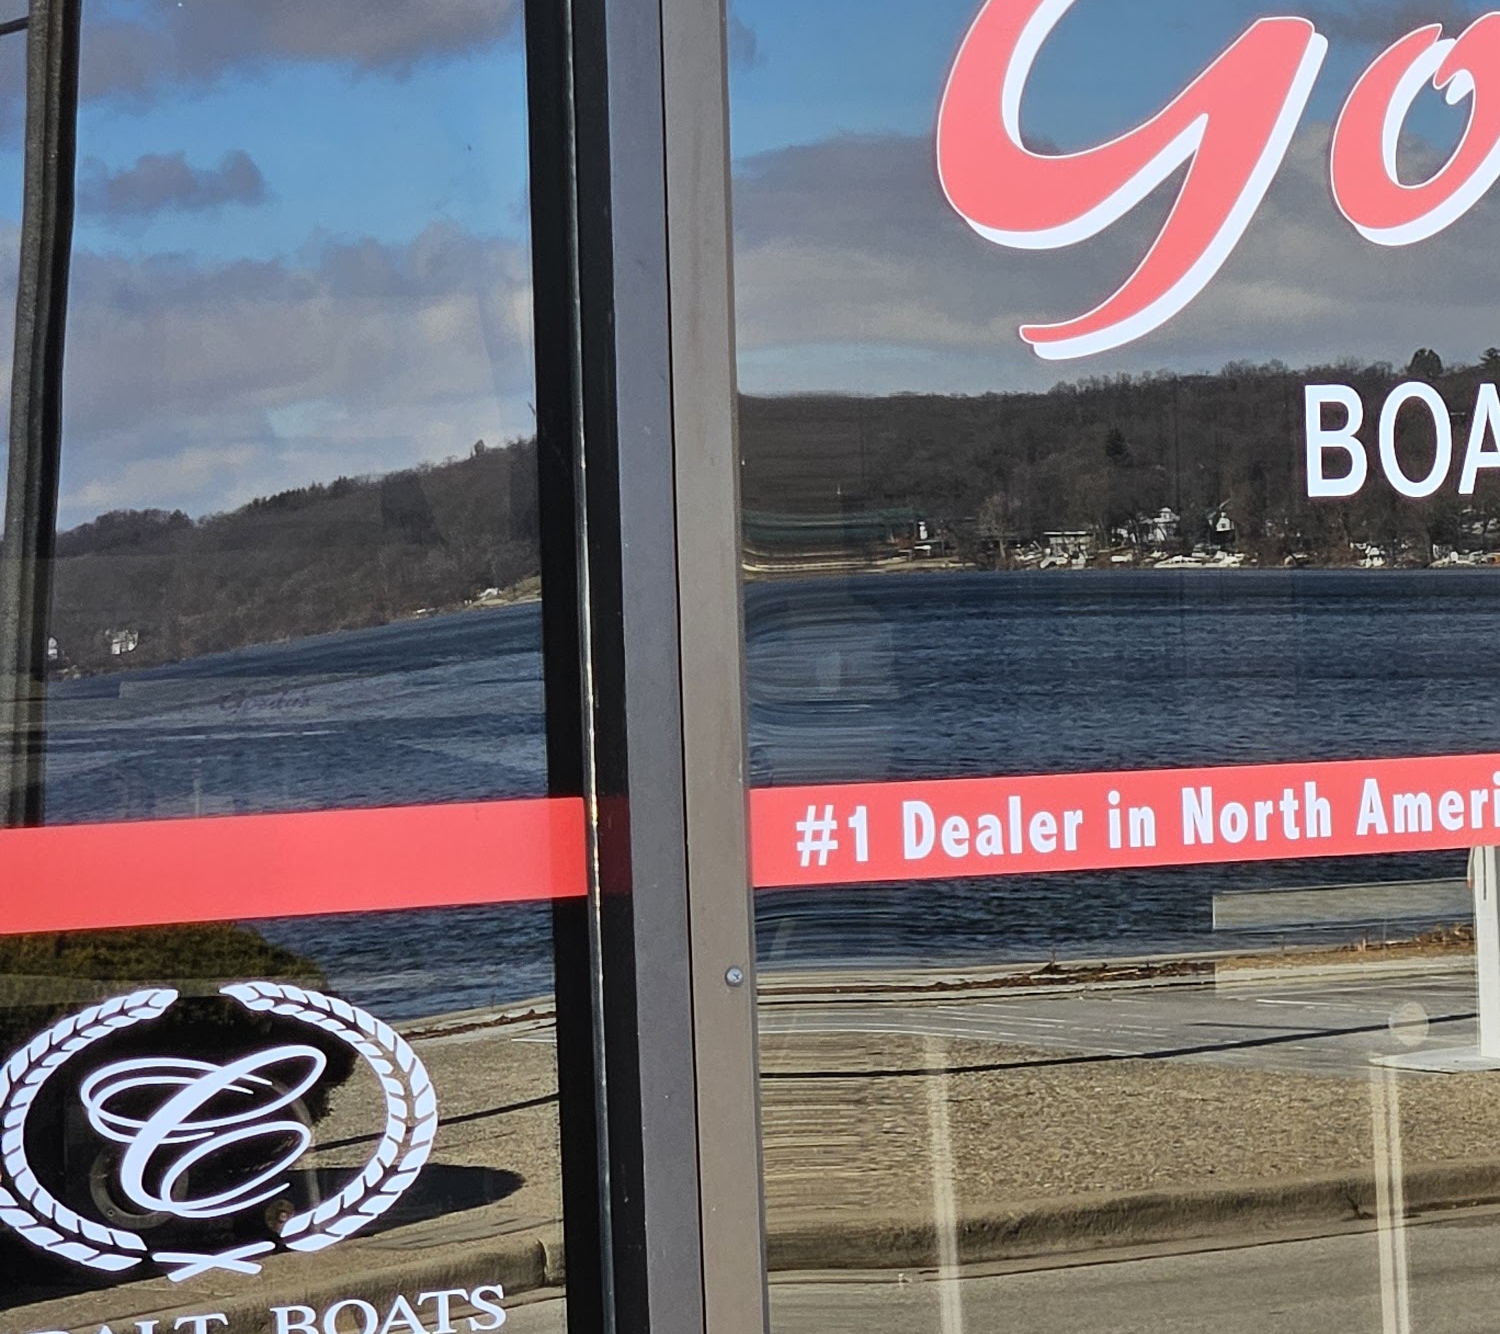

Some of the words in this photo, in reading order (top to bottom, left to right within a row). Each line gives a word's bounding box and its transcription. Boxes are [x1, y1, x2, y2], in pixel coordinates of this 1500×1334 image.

[796, 803, 870, 867] #1
[902, 794, 1084, 861] Dealer
[1107, 791, 1157, 848] in
[1182, 780, 1332, 845] North
